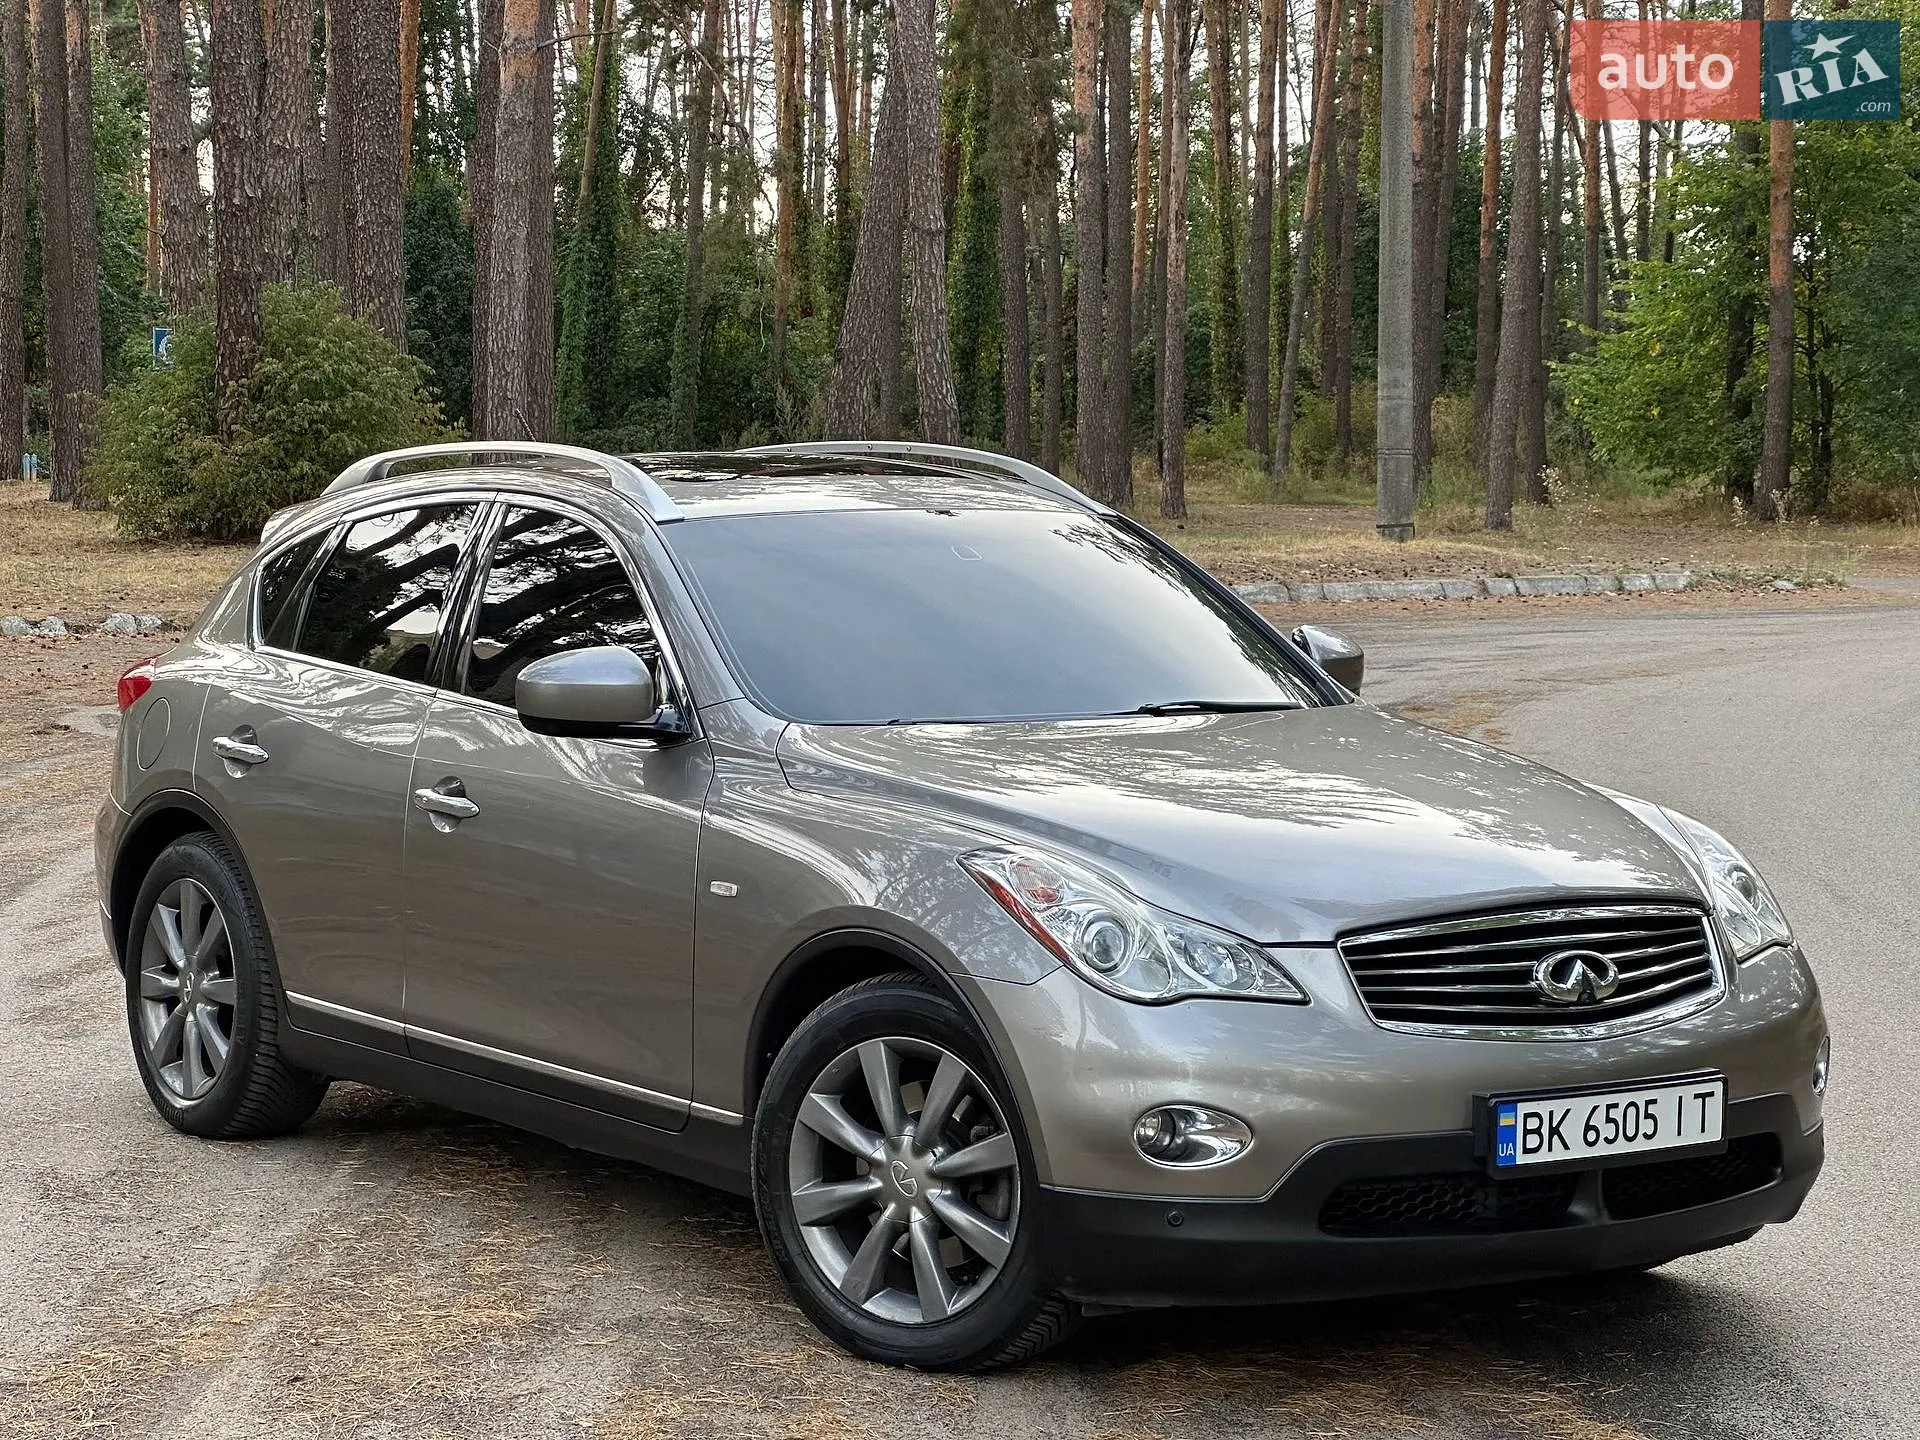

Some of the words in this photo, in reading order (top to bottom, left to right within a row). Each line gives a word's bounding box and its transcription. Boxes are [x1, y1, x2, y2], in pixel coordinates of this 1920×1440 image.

[1522, 1107, 1572, 1155] BK
[1582, 1098, 1658, 1147] 6505
[1676, 1090, 1715, 1136] IT
[1499, 1143, 1515, 1157] UA
